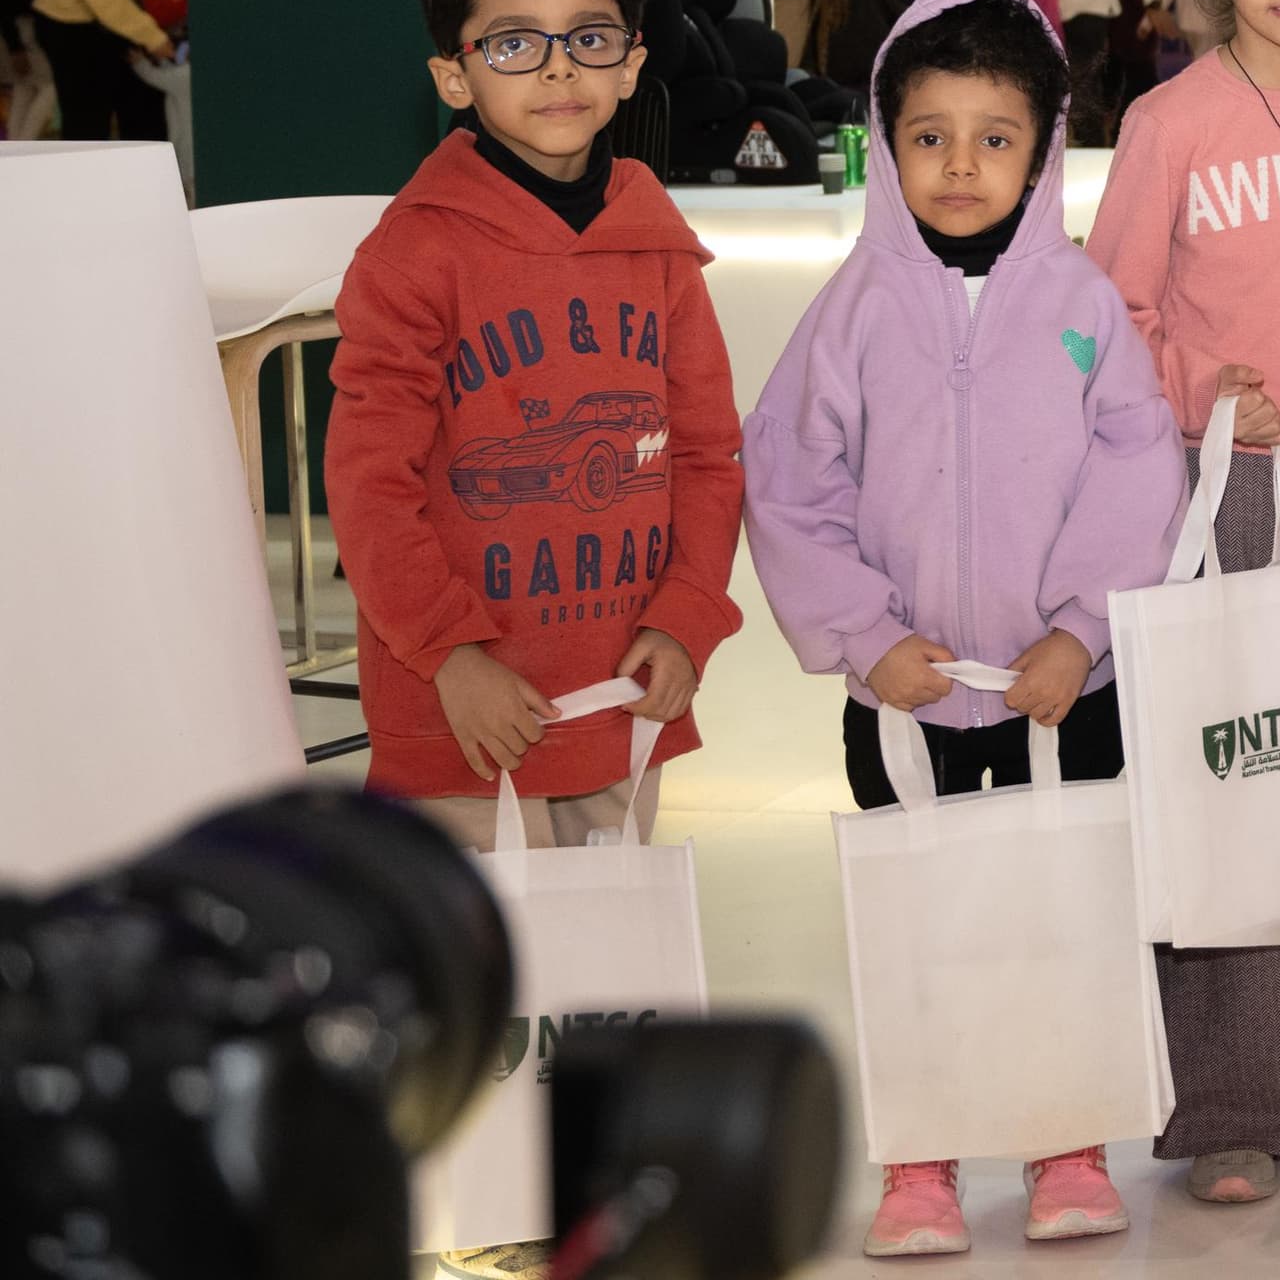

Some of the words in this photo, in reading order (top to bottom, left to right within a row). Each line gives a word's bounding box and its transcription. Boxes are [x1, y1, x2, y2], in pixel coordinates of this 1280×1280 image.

[568, 297, 601, 354] &
[619, 302, 667, 376] FA
[1242, 767, 1265, 778] National
